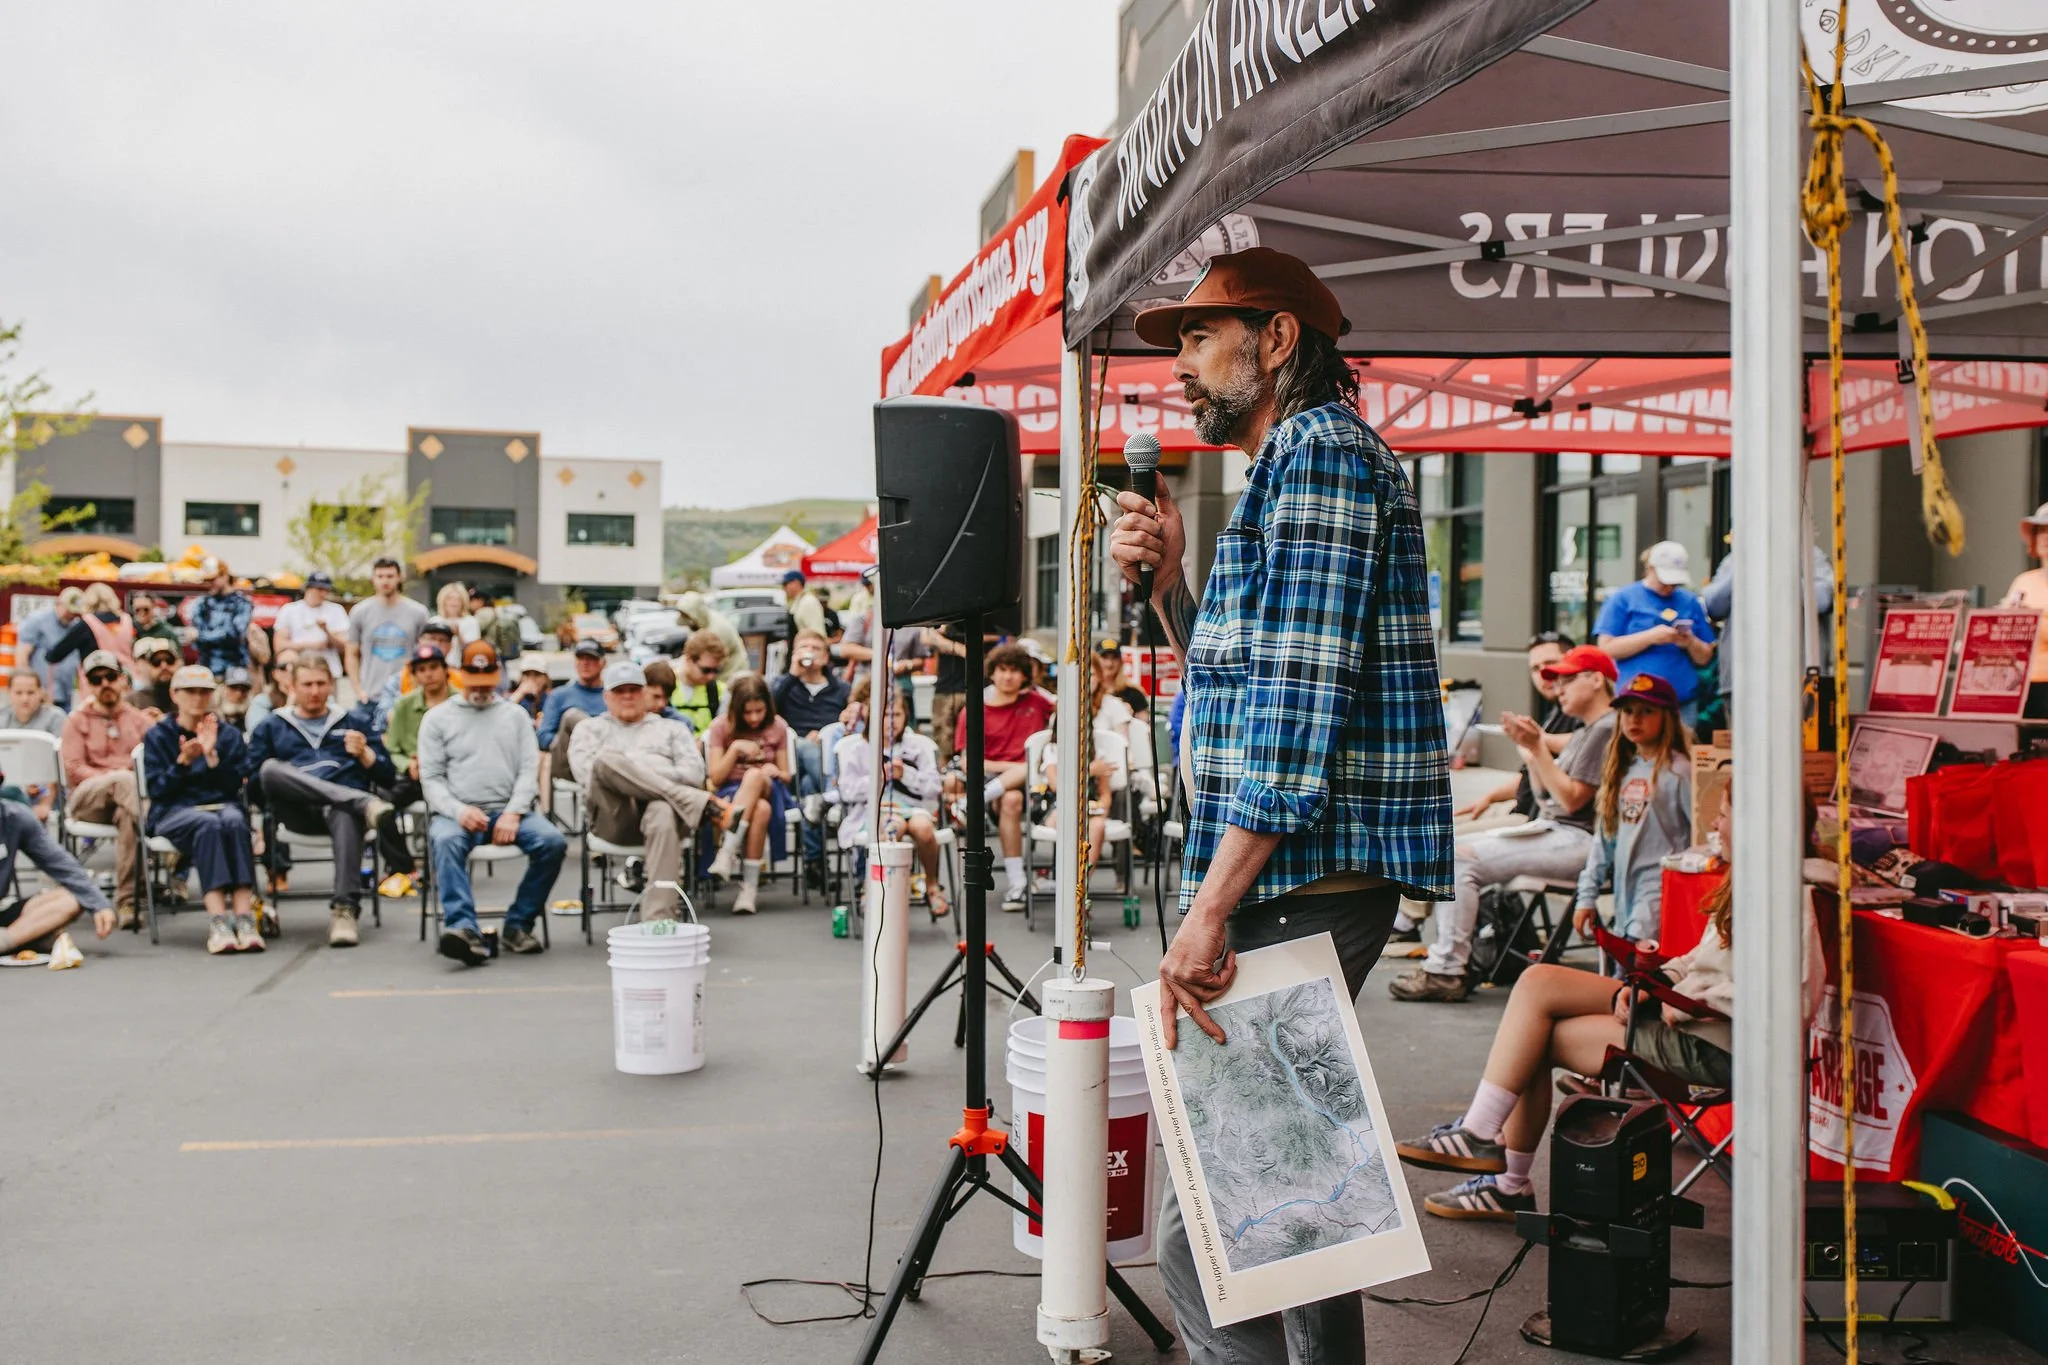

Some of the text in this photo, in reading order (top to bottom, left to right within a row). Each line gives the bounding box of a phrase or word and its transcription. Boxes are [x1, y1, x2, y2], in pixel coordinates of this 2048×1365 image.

[1149, 1024, 1161, 1051] public
[1158, 1063, 1169, 1087] open
[1163, 1088, 1176, 1115] finally
[1171, 1117, 1182, 1137] river
[1177, 1138, 1195, 1182] navigable
[1188, 1182, 1197, 1191] A
[1199, 1222, 1213, 1253] Weber
[1208, 1255, 1222, 1282] upper
[1217, 1283, 1228, 1302] The
